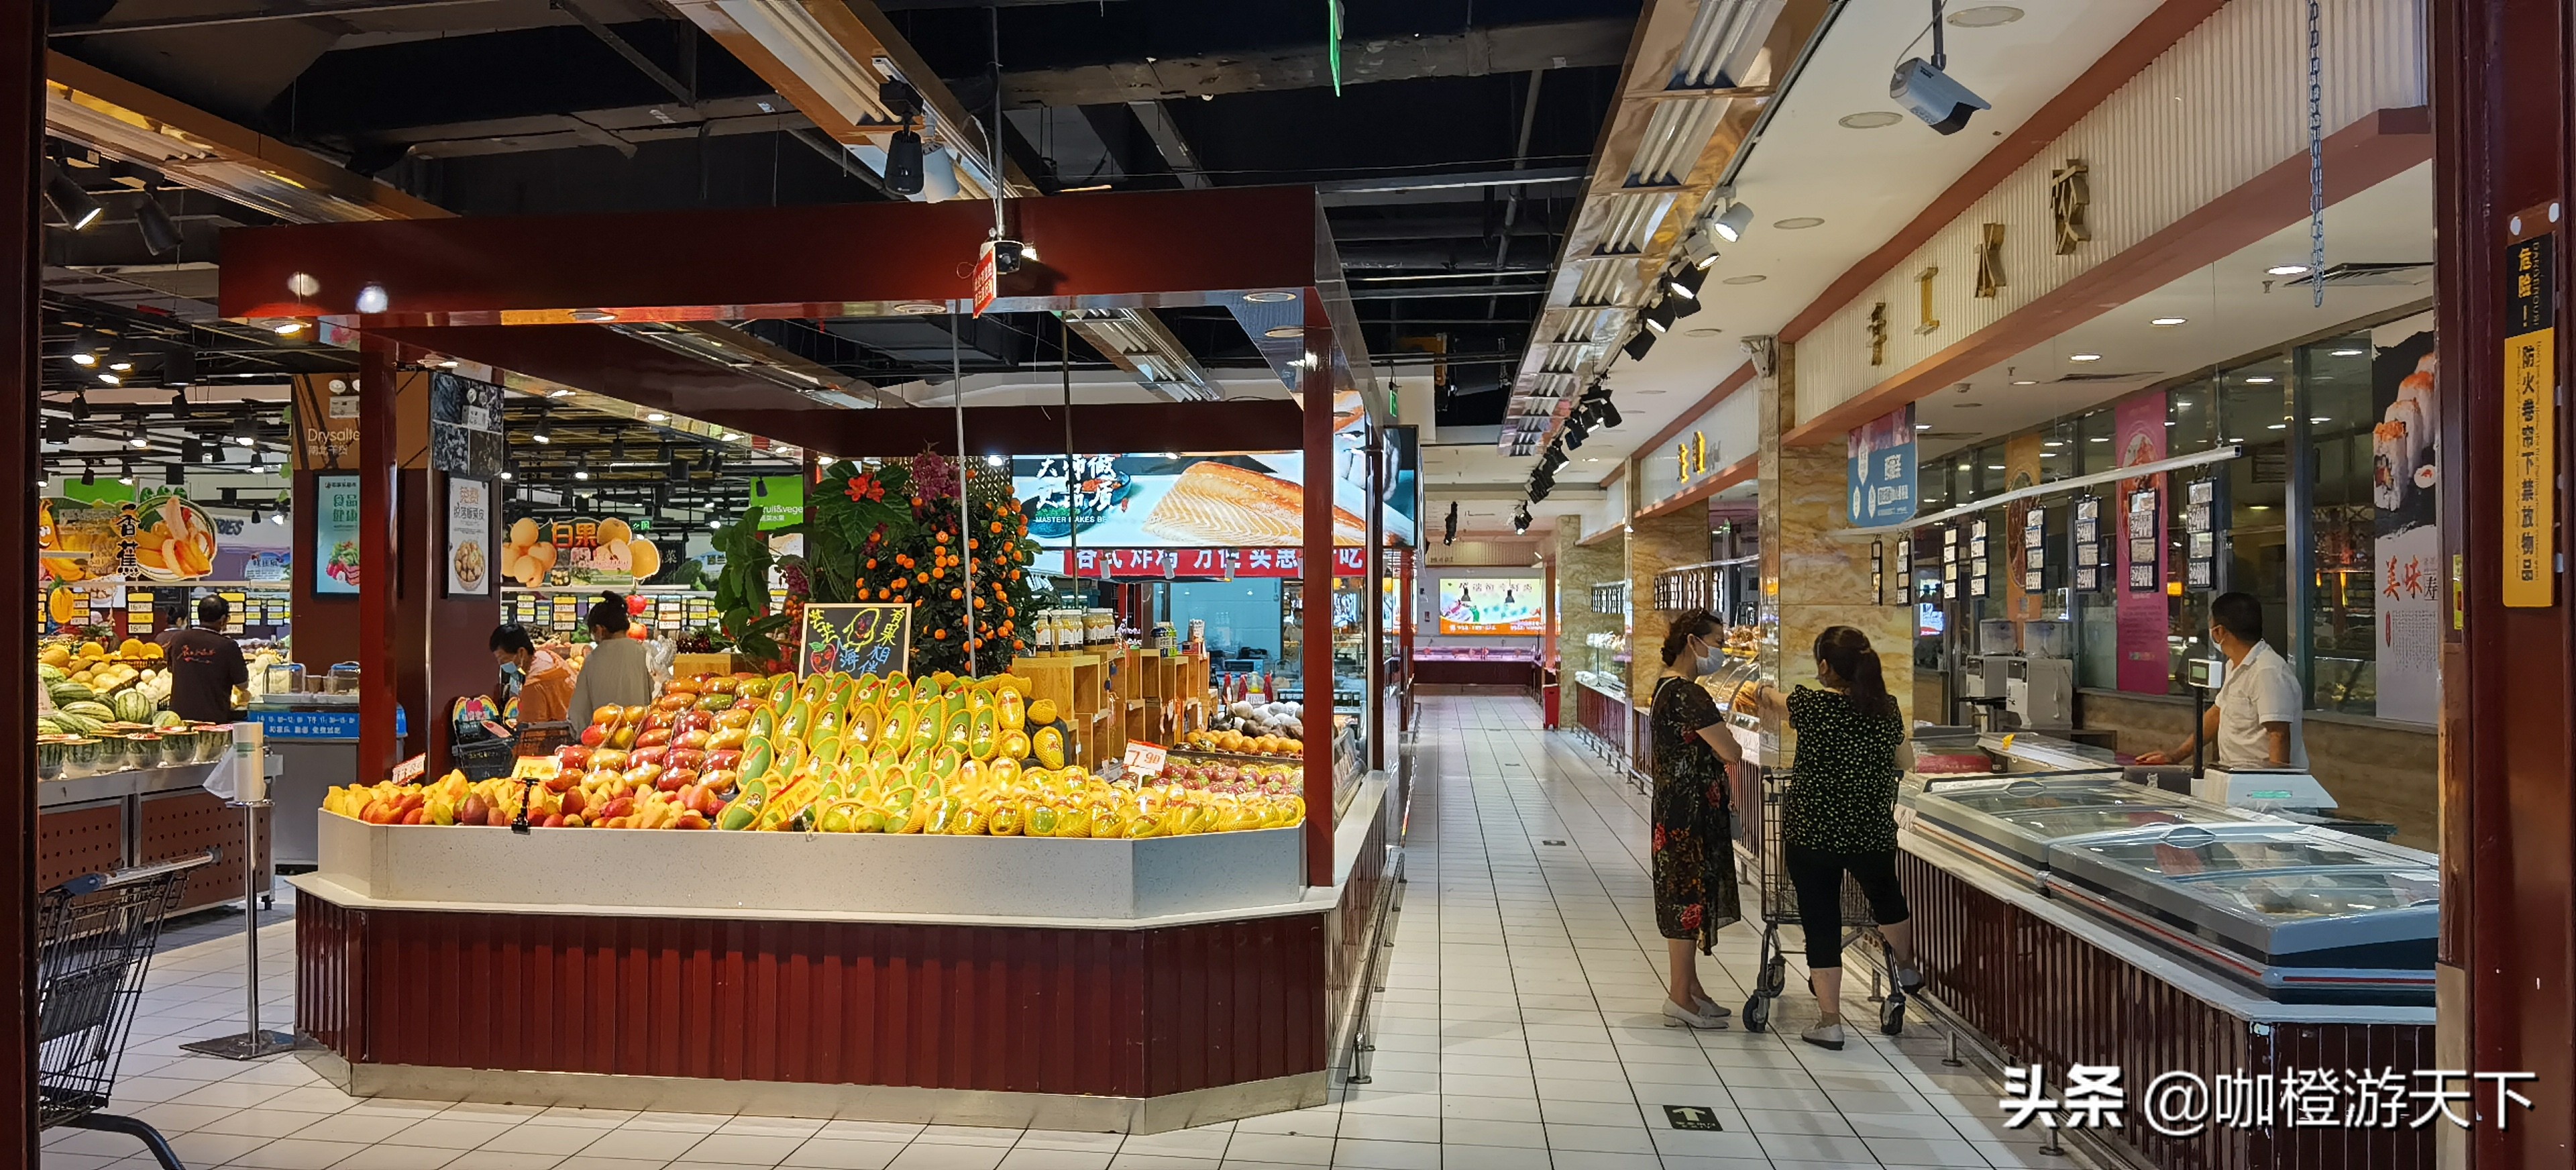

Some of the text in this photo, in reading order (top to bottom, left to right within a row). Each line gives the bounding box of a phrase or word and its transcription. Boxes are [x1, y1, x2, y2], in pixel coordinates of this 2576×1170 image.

[2521, 345, 2535, 582] 防火卷帘下禁放物品
[116, 504, 141, 576] 香蕉
[2383, 555, 2423, 602] 美味
